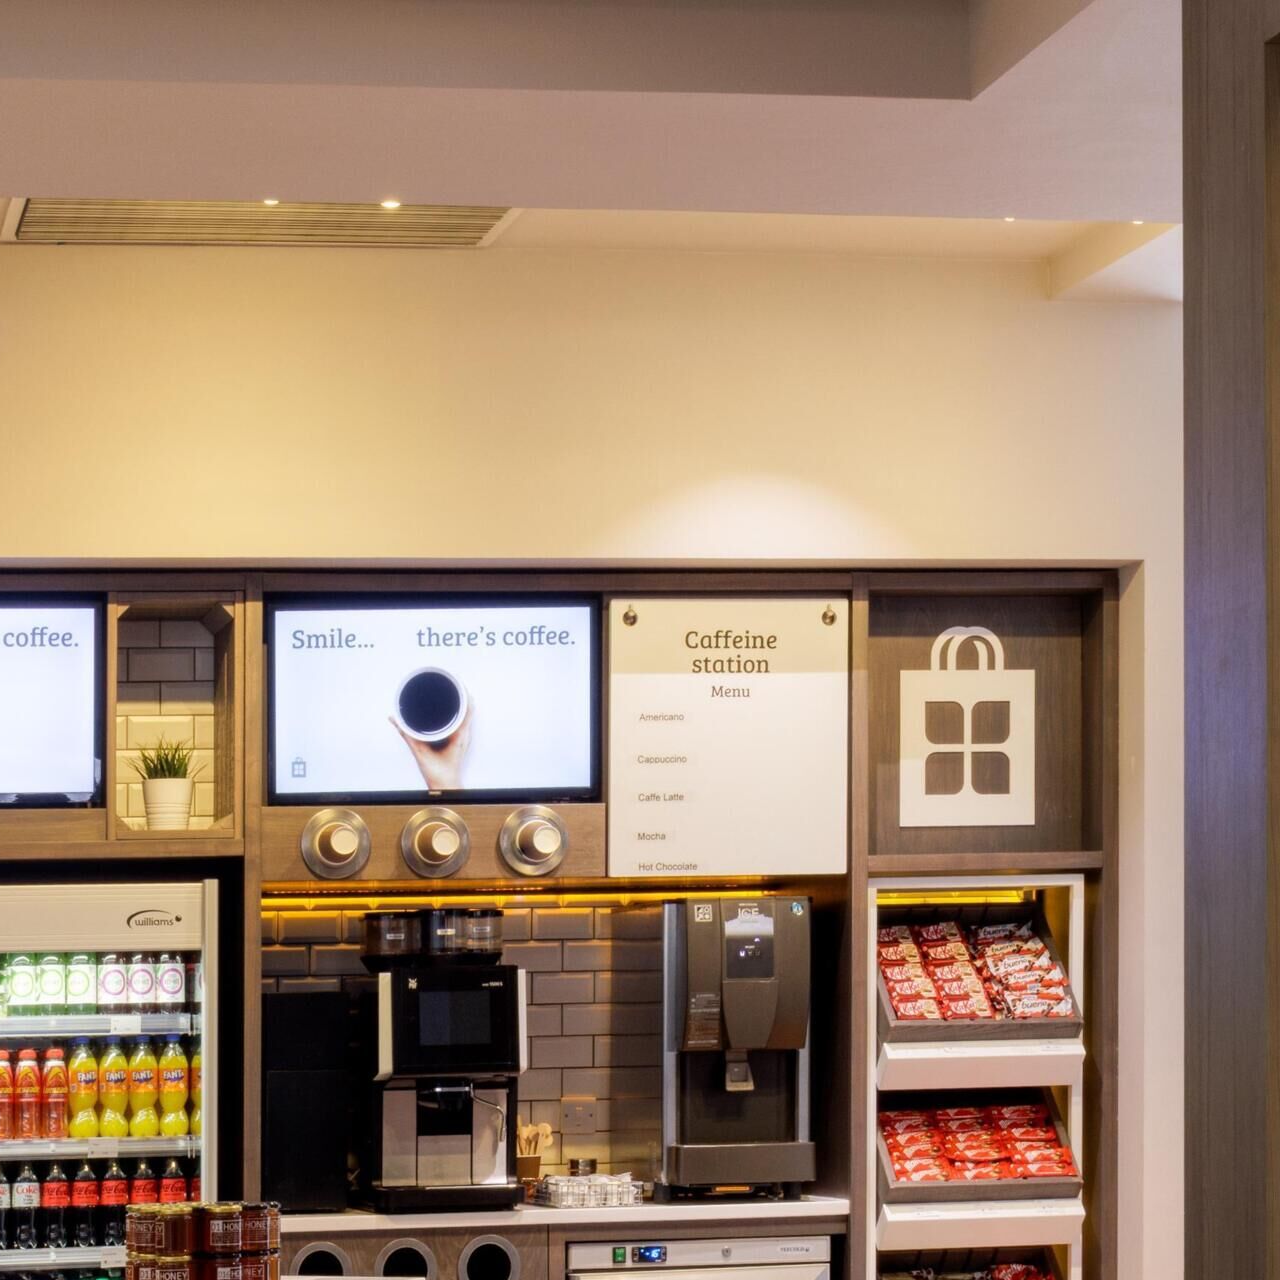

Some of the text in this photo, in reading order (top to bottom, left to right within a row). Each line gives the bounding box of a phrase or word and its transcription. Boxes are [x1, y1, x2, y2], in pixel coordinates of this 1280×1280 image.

[3, 627, 79, 648] coffee.
[292, 625, 576, 649] Smile... there’s coffee.
[685, 630, 777, 650] Caffeine
[691, 655, 770, 674] station
[710, 685, 751, 698] Menu
[639, 713, 685, 722] Americano
[637, 755, 687, 764] Cappuccino
[638, 793, 685, 802] Caffe Latte
[637, 831, 666, 841] Mocha
[638, 861, 698, 871] Hot Chocolate
[134, 917, 175, 926] williams
[245, 1221, 267, 1230] HONE
[160, 1271, 188, 1280] HONEY
